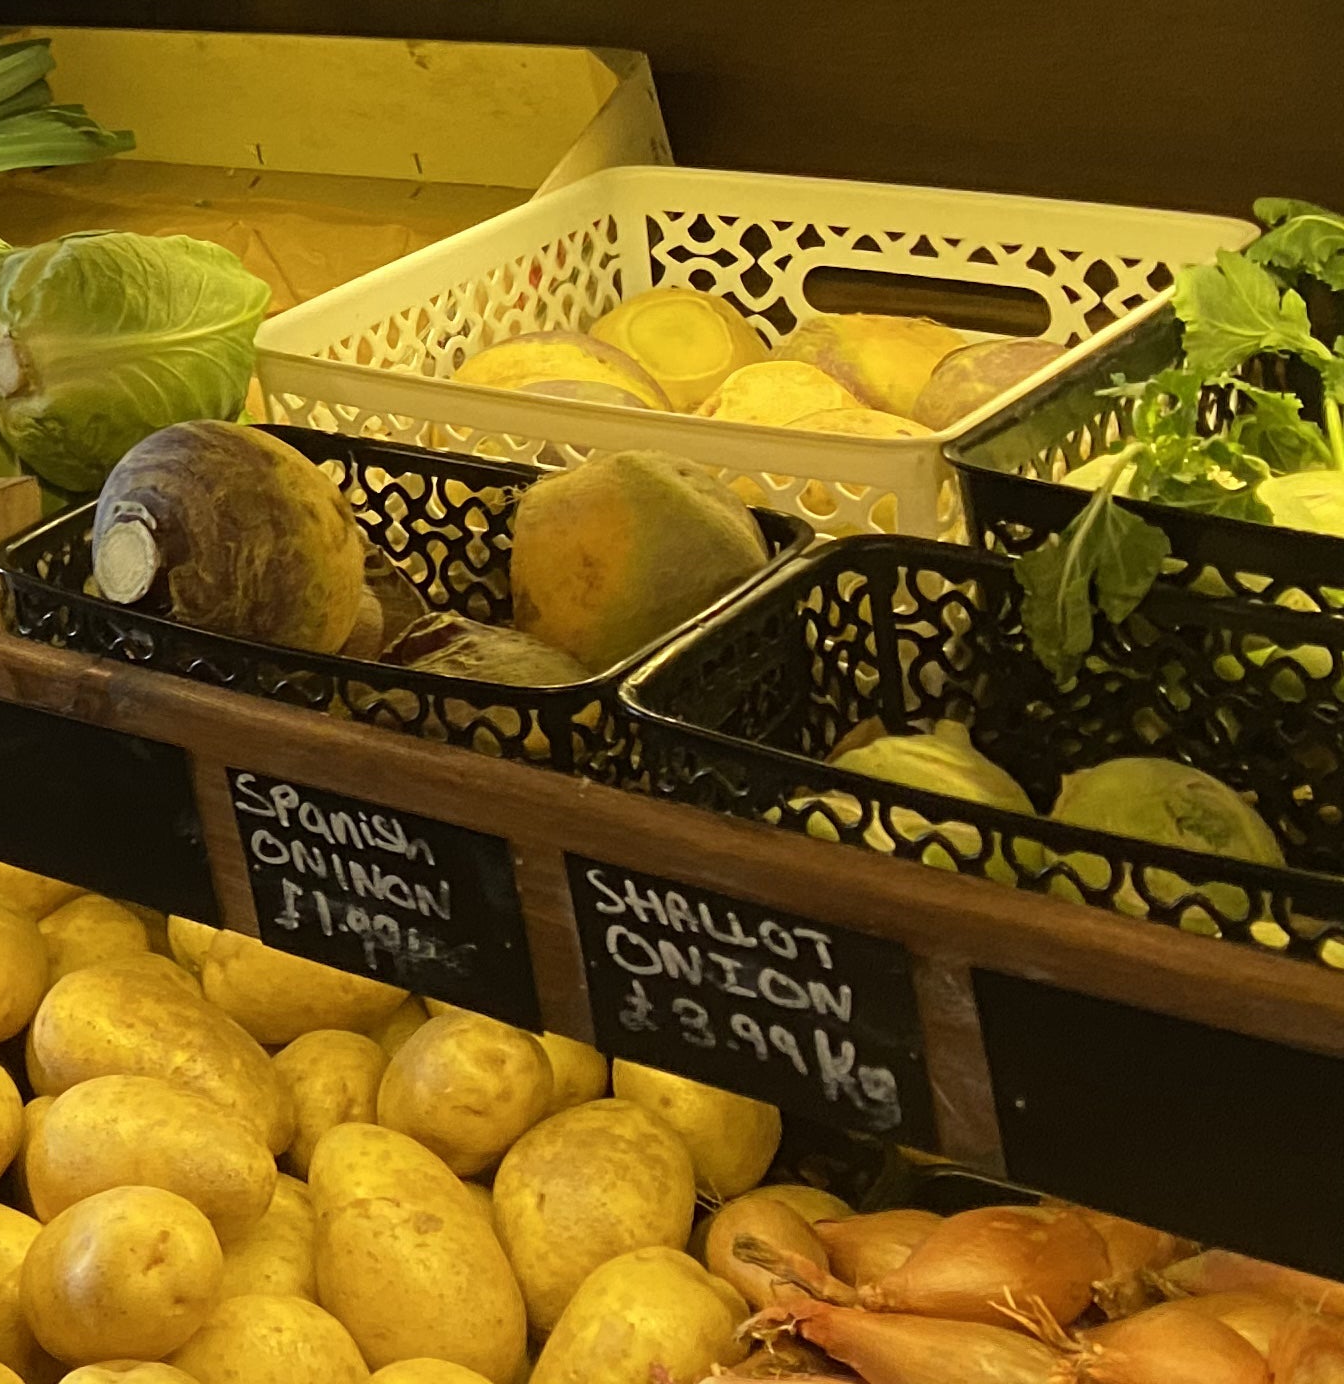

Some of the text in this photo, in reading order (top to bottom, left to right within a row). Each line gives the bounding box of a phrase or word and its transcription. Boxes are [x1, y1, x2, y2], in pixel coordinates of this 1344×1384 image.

[250, 829, 452, 921] ONINON
[586, 868, 833, 971] SHALLOT
[606, 924, 853, 1024] ONION
